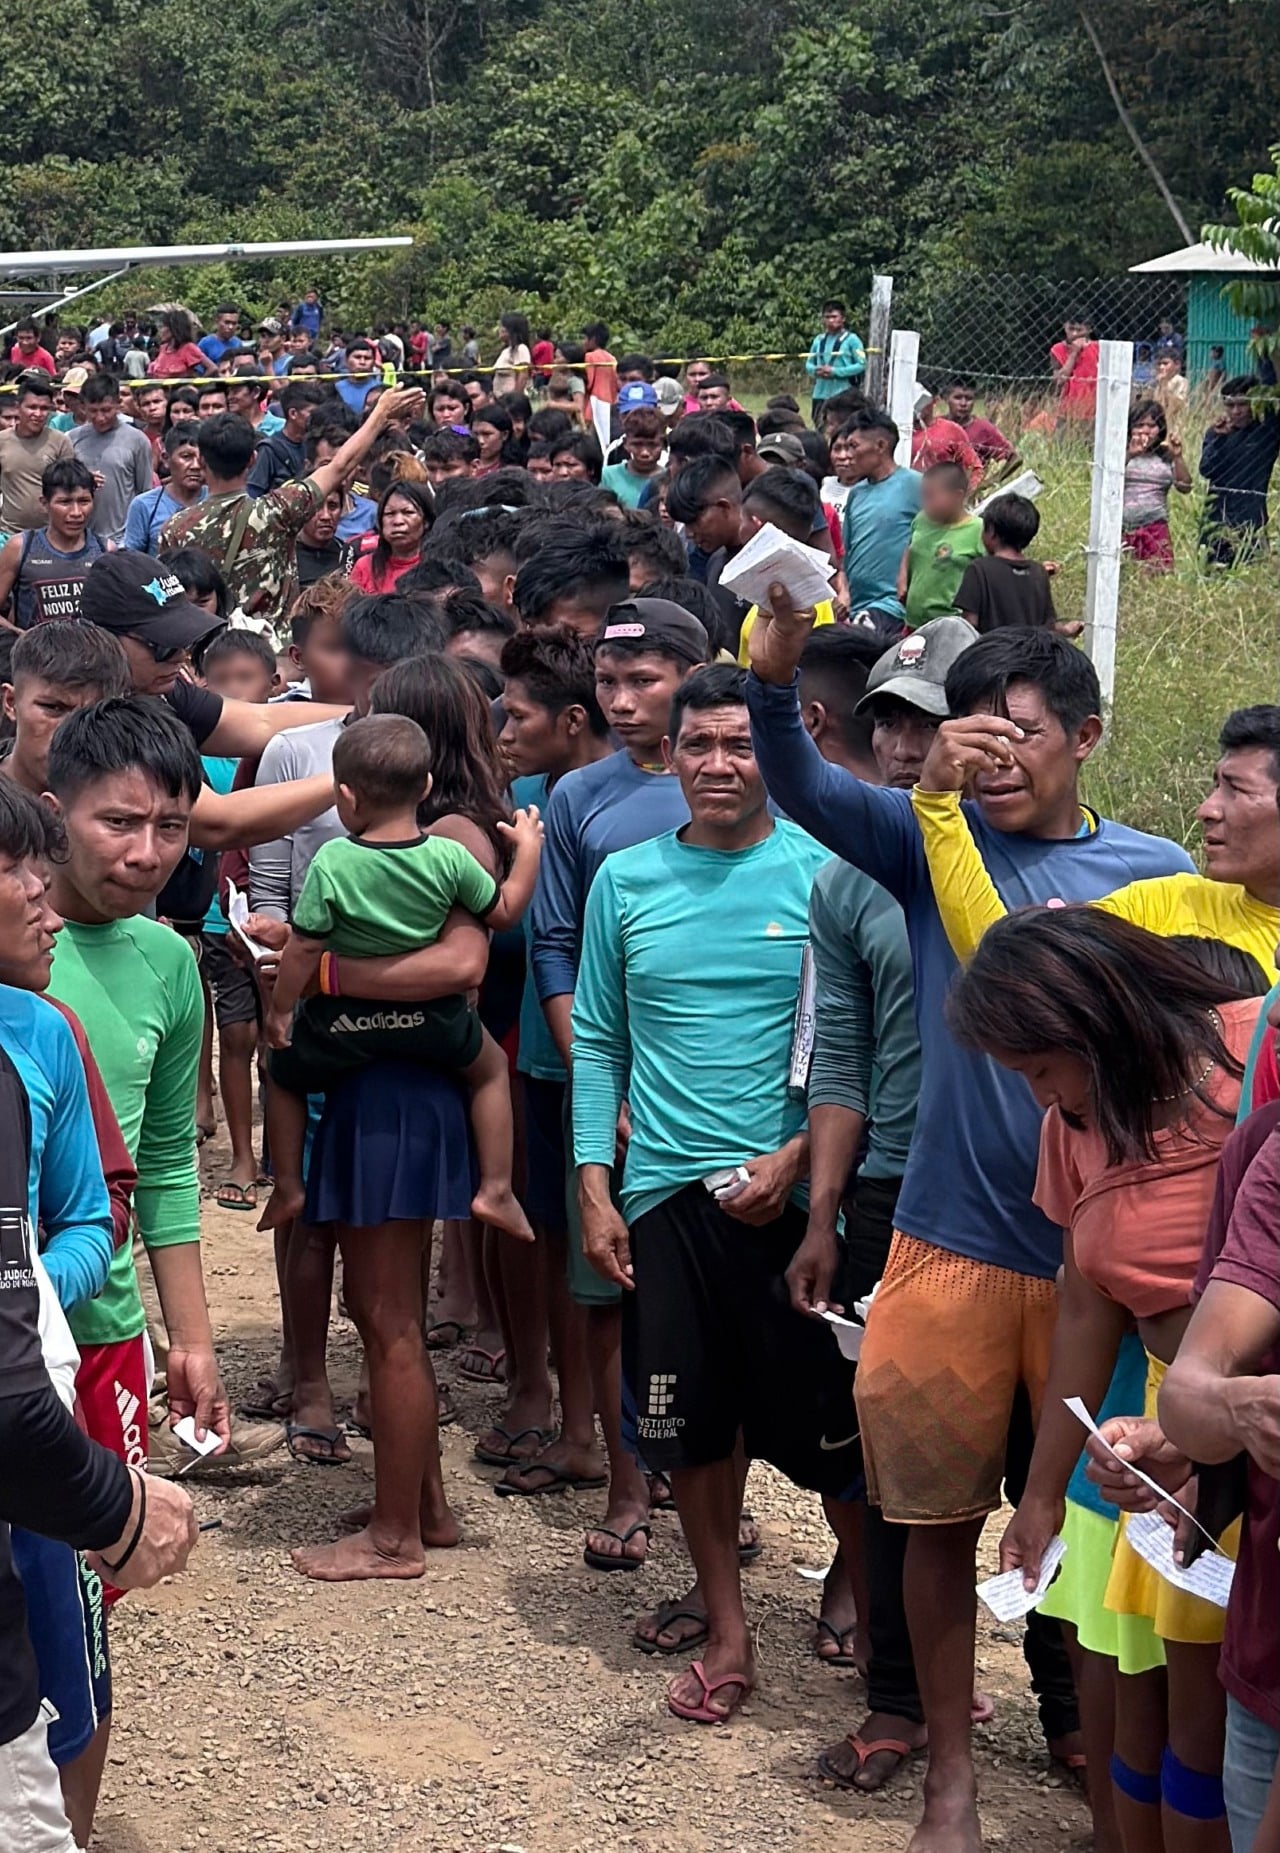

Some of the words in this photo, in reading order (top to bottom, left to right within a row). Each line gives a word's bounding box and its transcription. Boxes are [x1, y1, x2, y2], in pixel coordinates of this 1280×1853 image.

[41, 583, 71, 599] FELIZ
[43, 600, 74, 616] NOVO
[356, 1010, 425, 1031] adidas
[12, 1280, 20, 1288] DE
[637, 1416, 686, 1428] NSTITUTO
[638, 1426, 678, 1438] FEDERAL
